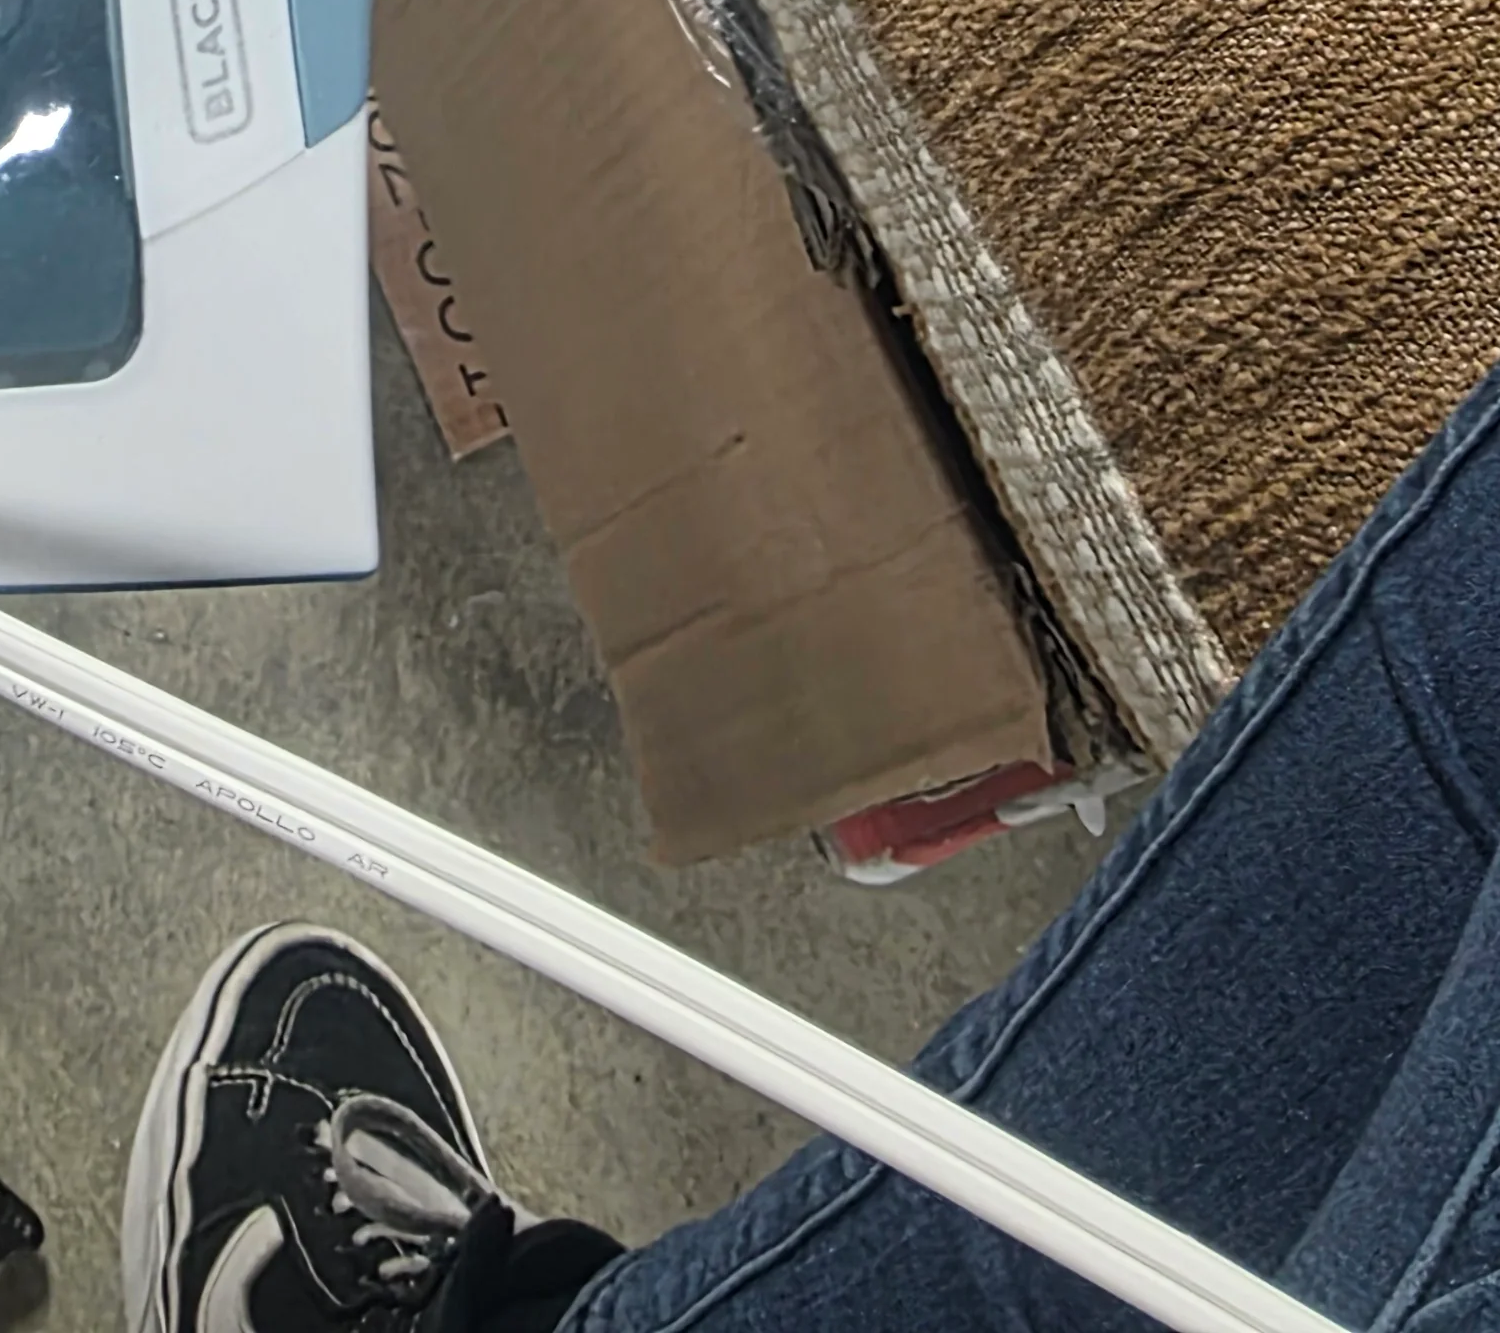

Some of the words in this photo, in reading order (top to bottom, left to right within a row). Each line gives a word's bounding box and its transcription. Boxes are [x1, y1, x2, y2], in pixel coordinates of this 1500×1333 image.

[11, 683, 66, 721] VW-1
[195, 779, 316, 843] APOLLO
[346, 851, 390, 878] AR
